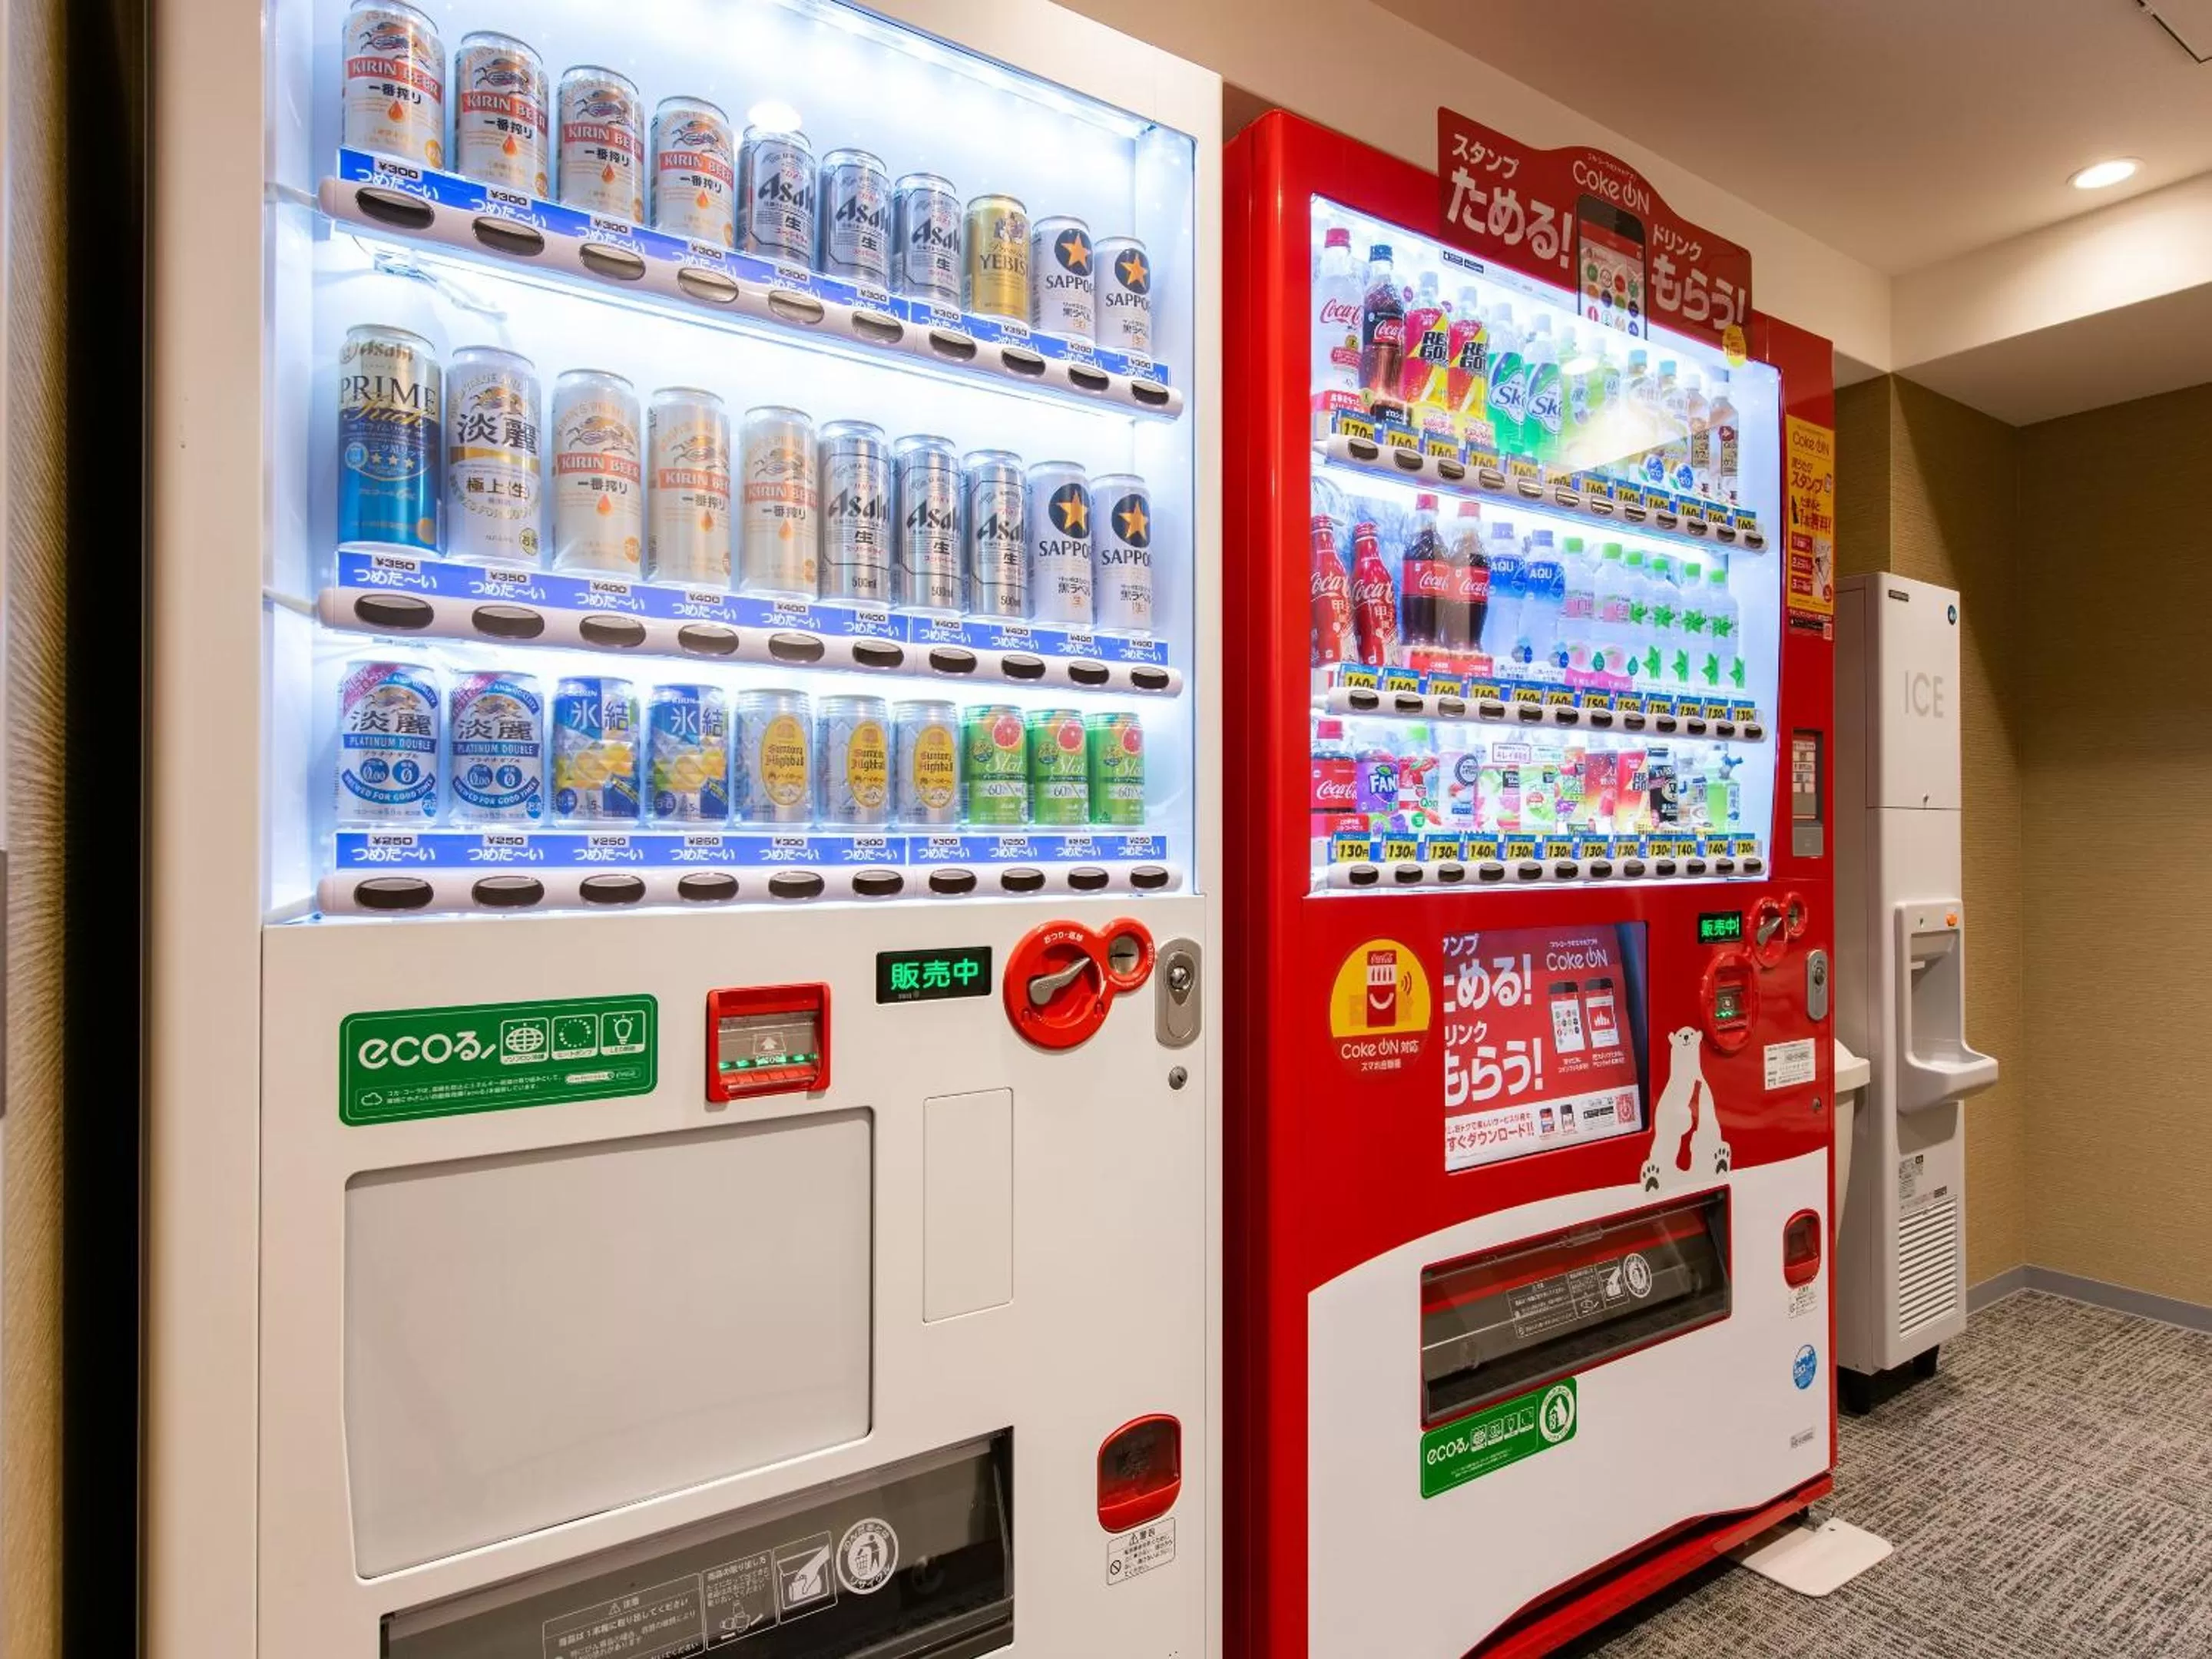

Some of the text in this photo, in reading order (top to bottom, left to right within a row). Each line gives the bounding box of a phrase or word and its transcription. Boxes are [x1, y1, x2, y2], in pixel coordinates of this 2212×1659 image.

[663, 153, 701, 168] KIRIN
[1452, 133, 1519, 179] スタンプ
[377, 161, 419, 180] ¥300
[1572, 160, 1619, 200] Coke
[1623, 180, 1650, 215] ON
[491, 190, 528, 207] ¥300
[594, 218, 628, 234] ¥300
[1447, 166, 1573, 270] ためる!
[691, 243, 722, 260] ¥300
[1652, 224, 1703, 262] ドリンク
[1651, 253, 1745, 330] もらう!
[341, 376, 435, 415] PRIME
[458, 413, 536, 455] 淡麗
[561, 455, 601, 471] KIRIN
[376, 556, 416, 571] ¥350
[490, 571, 528, 584] ¥350
[591, 583, 627, 594] ¥400
[690, 592, 720, 603] ¥400
[777, 602, 806, 613] ¥400
[1904, 669, 1945, 719] ICE
[351, 711, 431, 736] 淡麗
[571, 700, 629, 730] 氷結
[671, 707, 724, 737] 氷結
[459, 720, 532, 740] 淡麗
[349, 737, 431, 750] PLATINUM DOUBLE
[502, 745, 533, 755] DOUBLE
[372, 836, 412, 846] ¥250
[487, 836, 525, 845] ¥250
[1700, 916, 1739, 938] 販売中
[1546, 946, 1608, 971] Coke ON
[891, 960, 979, 991] 販売中
[1341, 1041, 1376, 1060] Coke
[1379, 1038, 1399, 1058] ON
